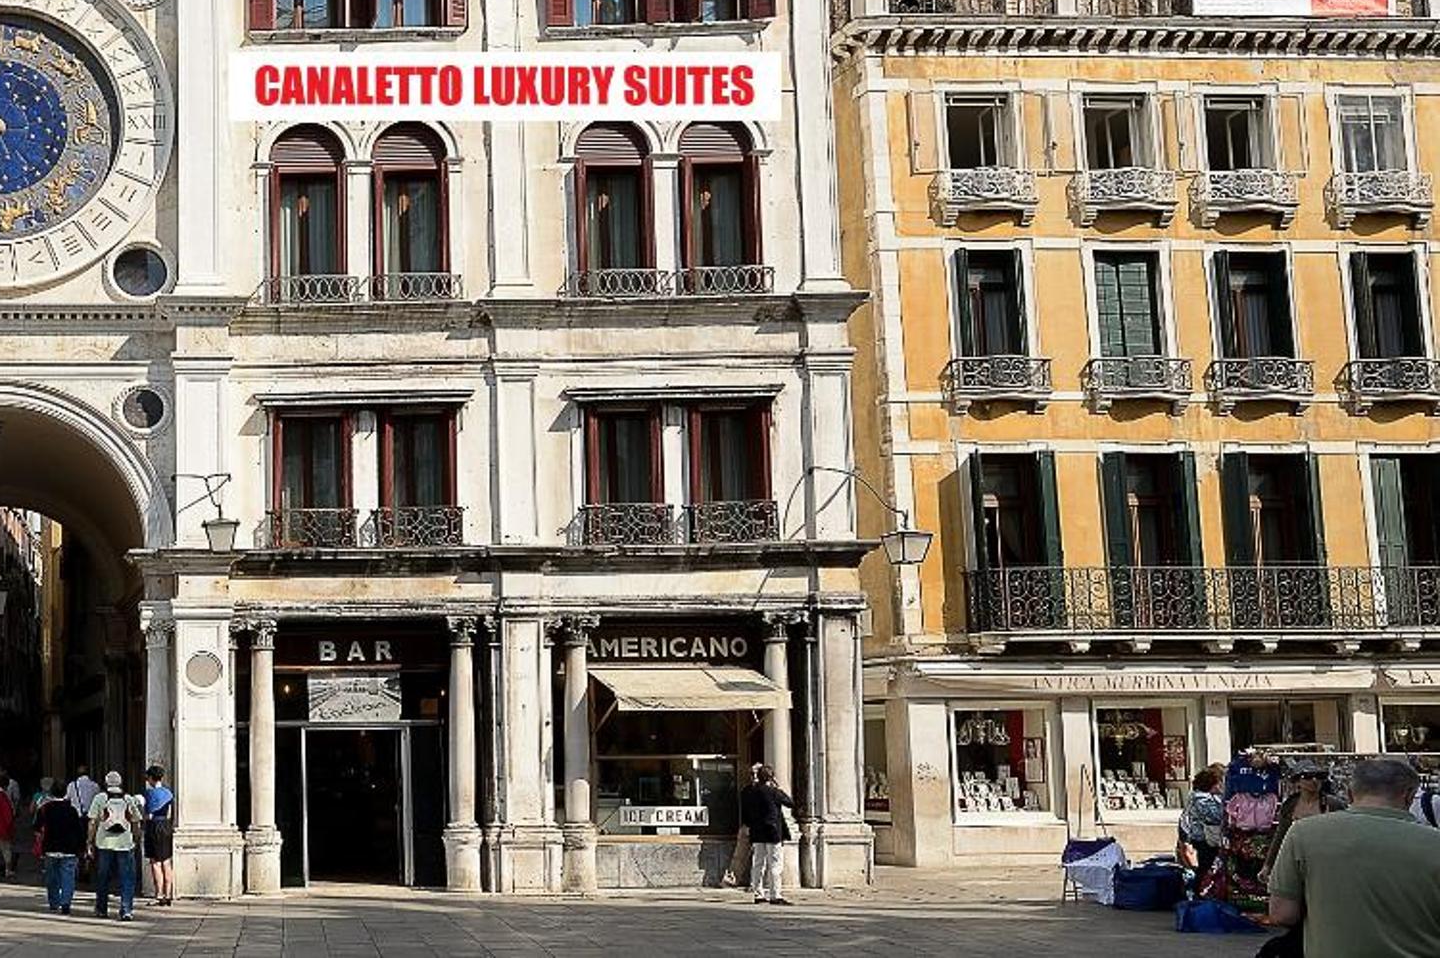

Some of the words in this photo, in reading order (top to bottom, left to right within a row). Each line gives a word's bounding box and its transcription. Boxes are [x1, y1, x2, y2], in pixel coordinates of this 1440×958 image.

[318, 640, 393, 661] BAR
[587, 637, 748, 657] AMERICANO
[656, 809, 704, 823] CREAM
